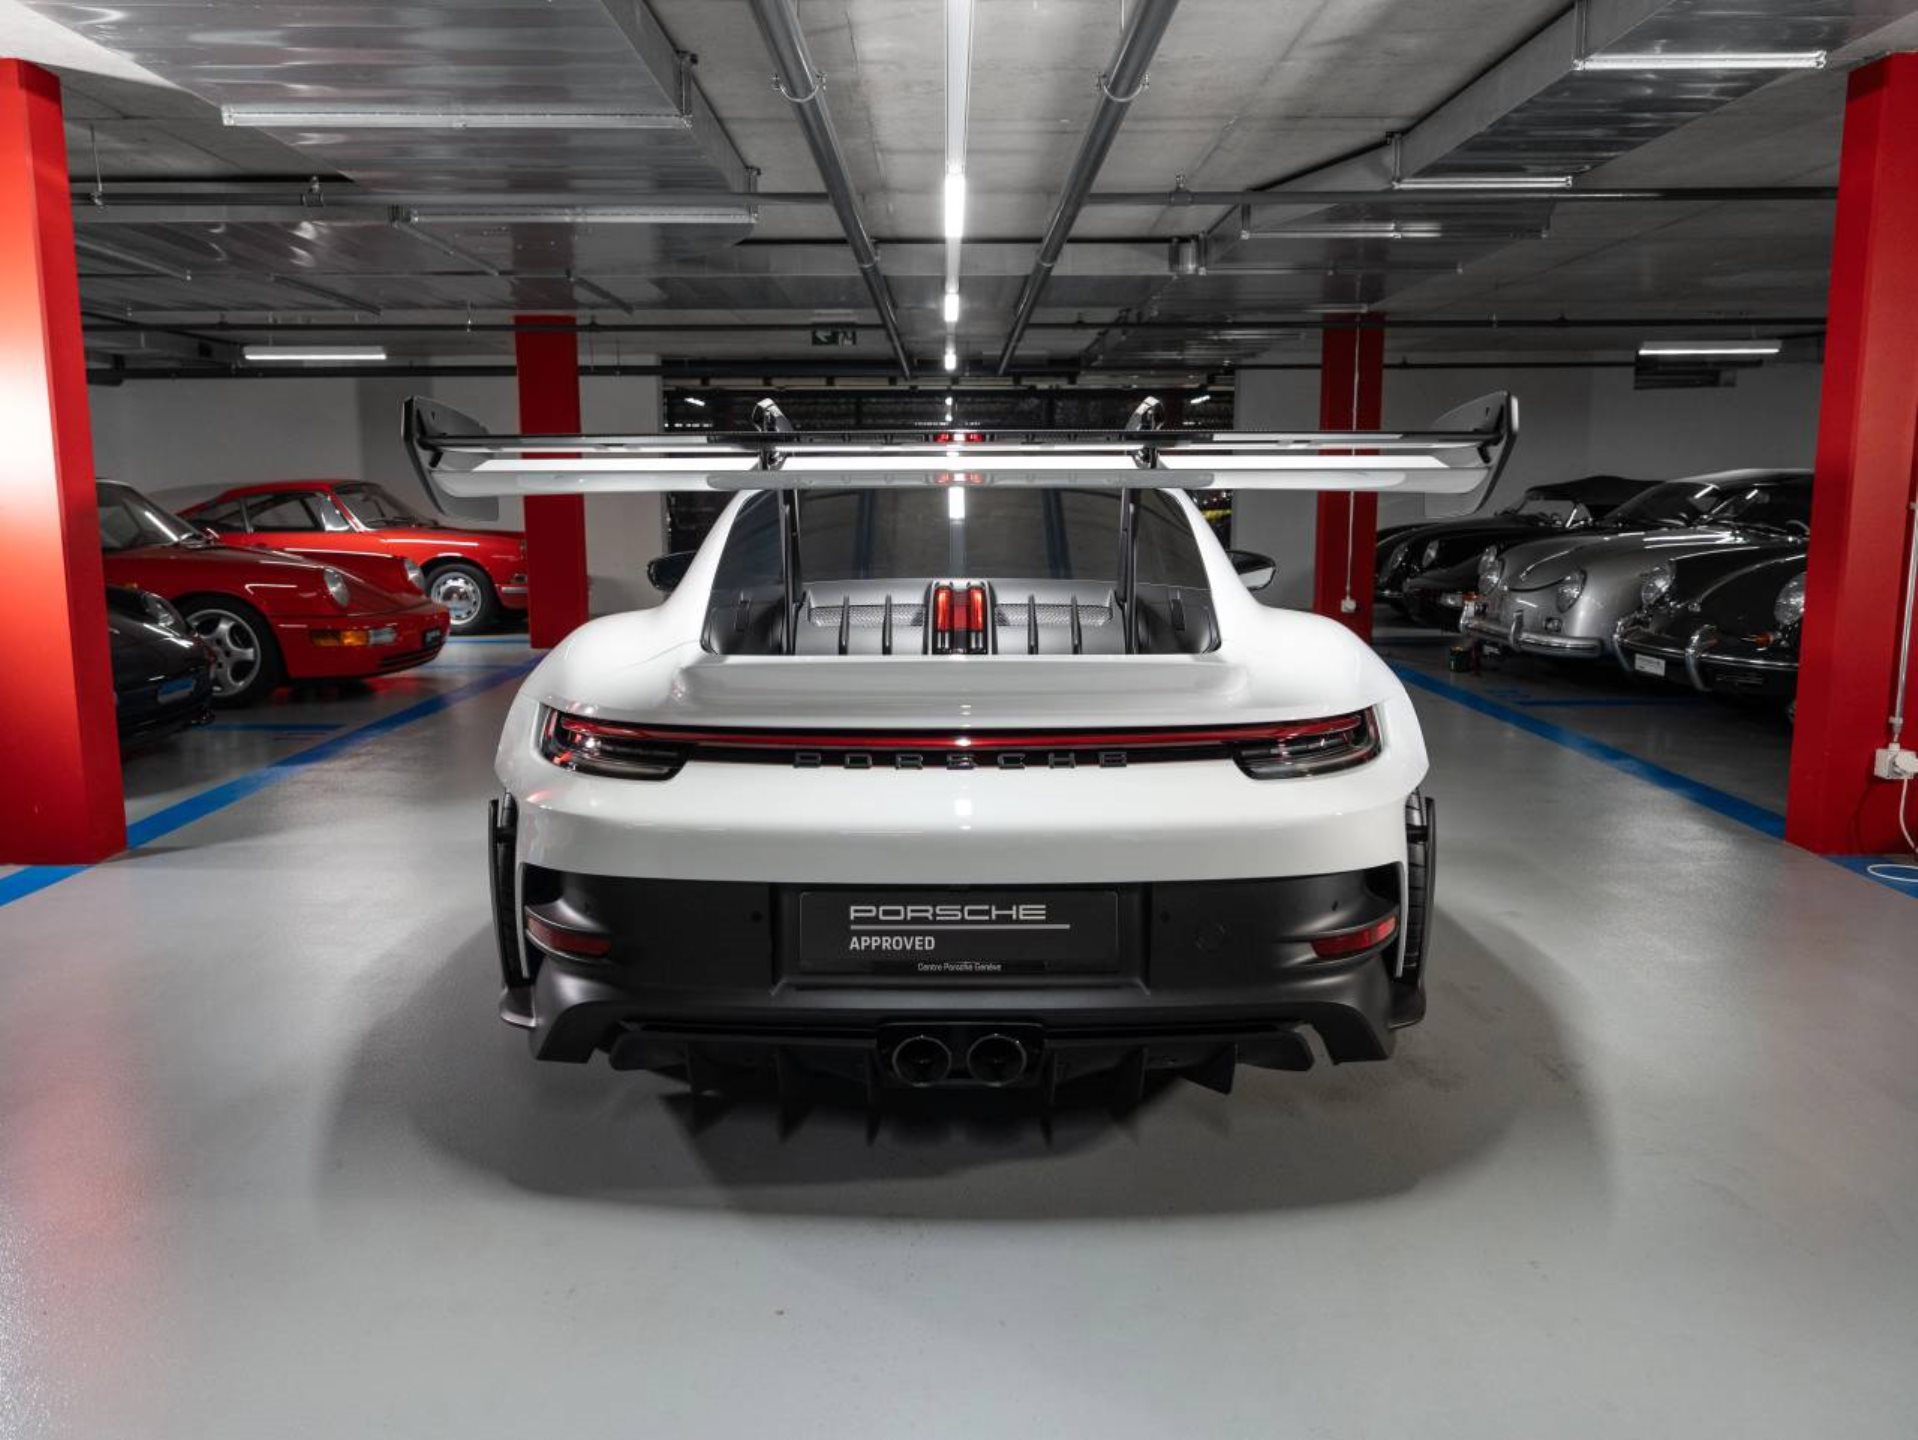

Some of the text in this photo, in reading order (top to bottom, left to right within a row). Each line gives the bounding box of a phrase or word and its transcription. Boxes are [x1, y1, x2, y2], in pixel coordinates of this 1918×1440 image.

[793, 752, 1127, 770] PORSCHE
[850, 904, 1046, 921] PORSCHE
[849, 936, 935, 951] APPROVED
